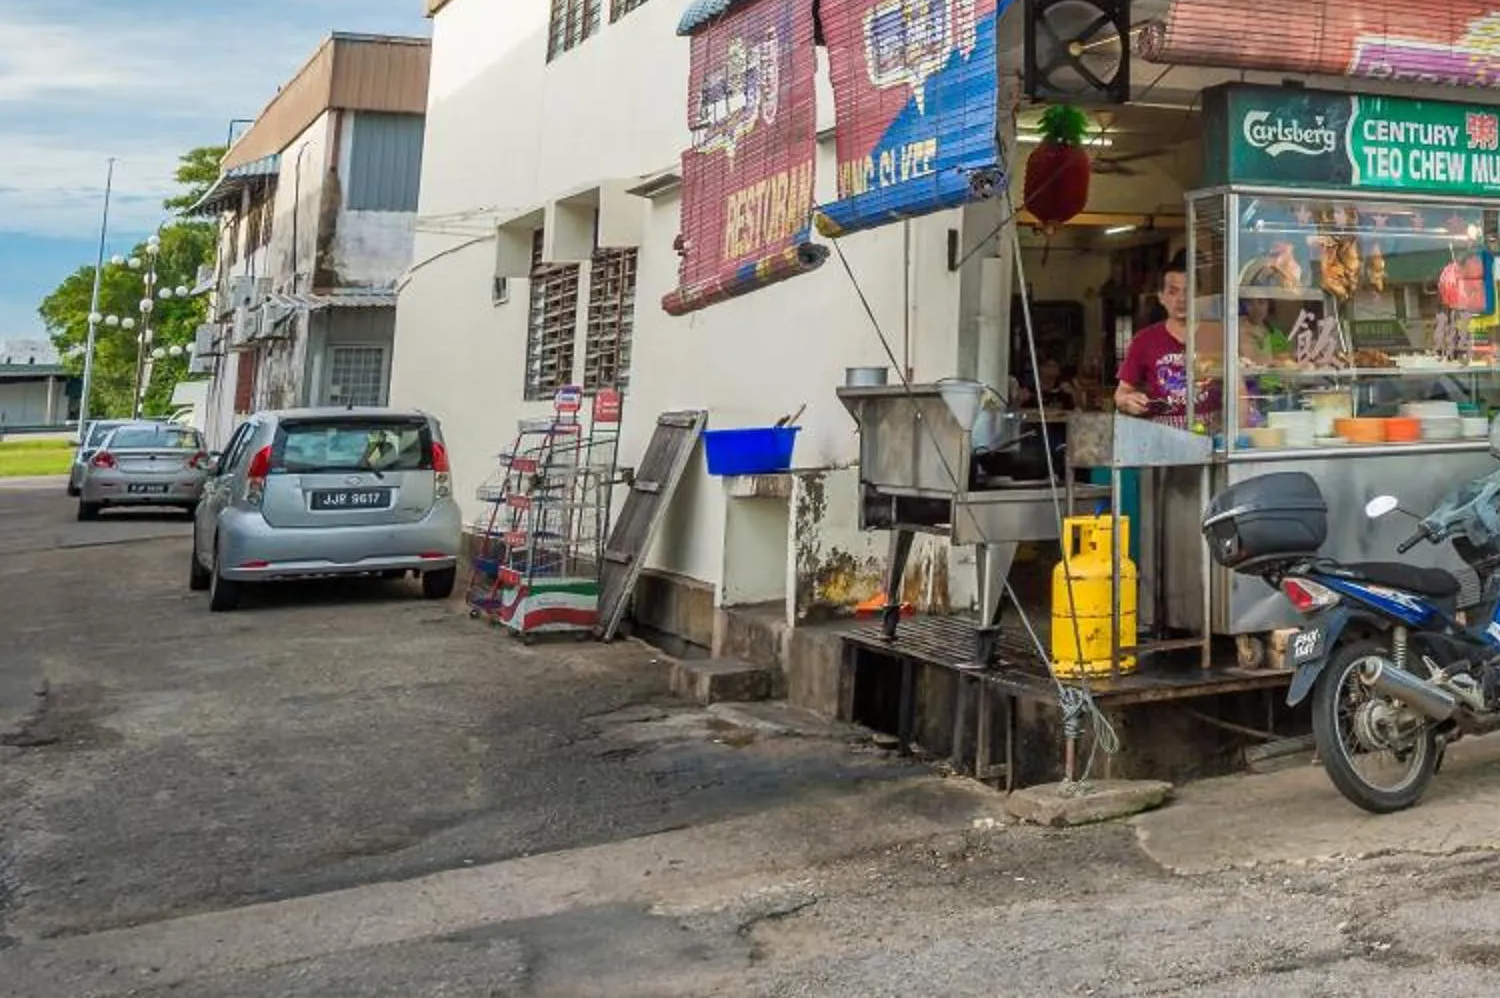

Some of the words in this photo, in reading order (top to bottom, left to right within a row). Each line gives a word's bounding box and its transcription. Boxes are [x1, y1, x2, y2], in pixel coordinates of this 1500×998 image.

[1243, 111, 1336, 156] Carlsberg
[1362, 119, 1459, 147] CENTURY
[1363, 147, 1401, 180] TEO
[1408, 149, 1465, 183] CHEW
